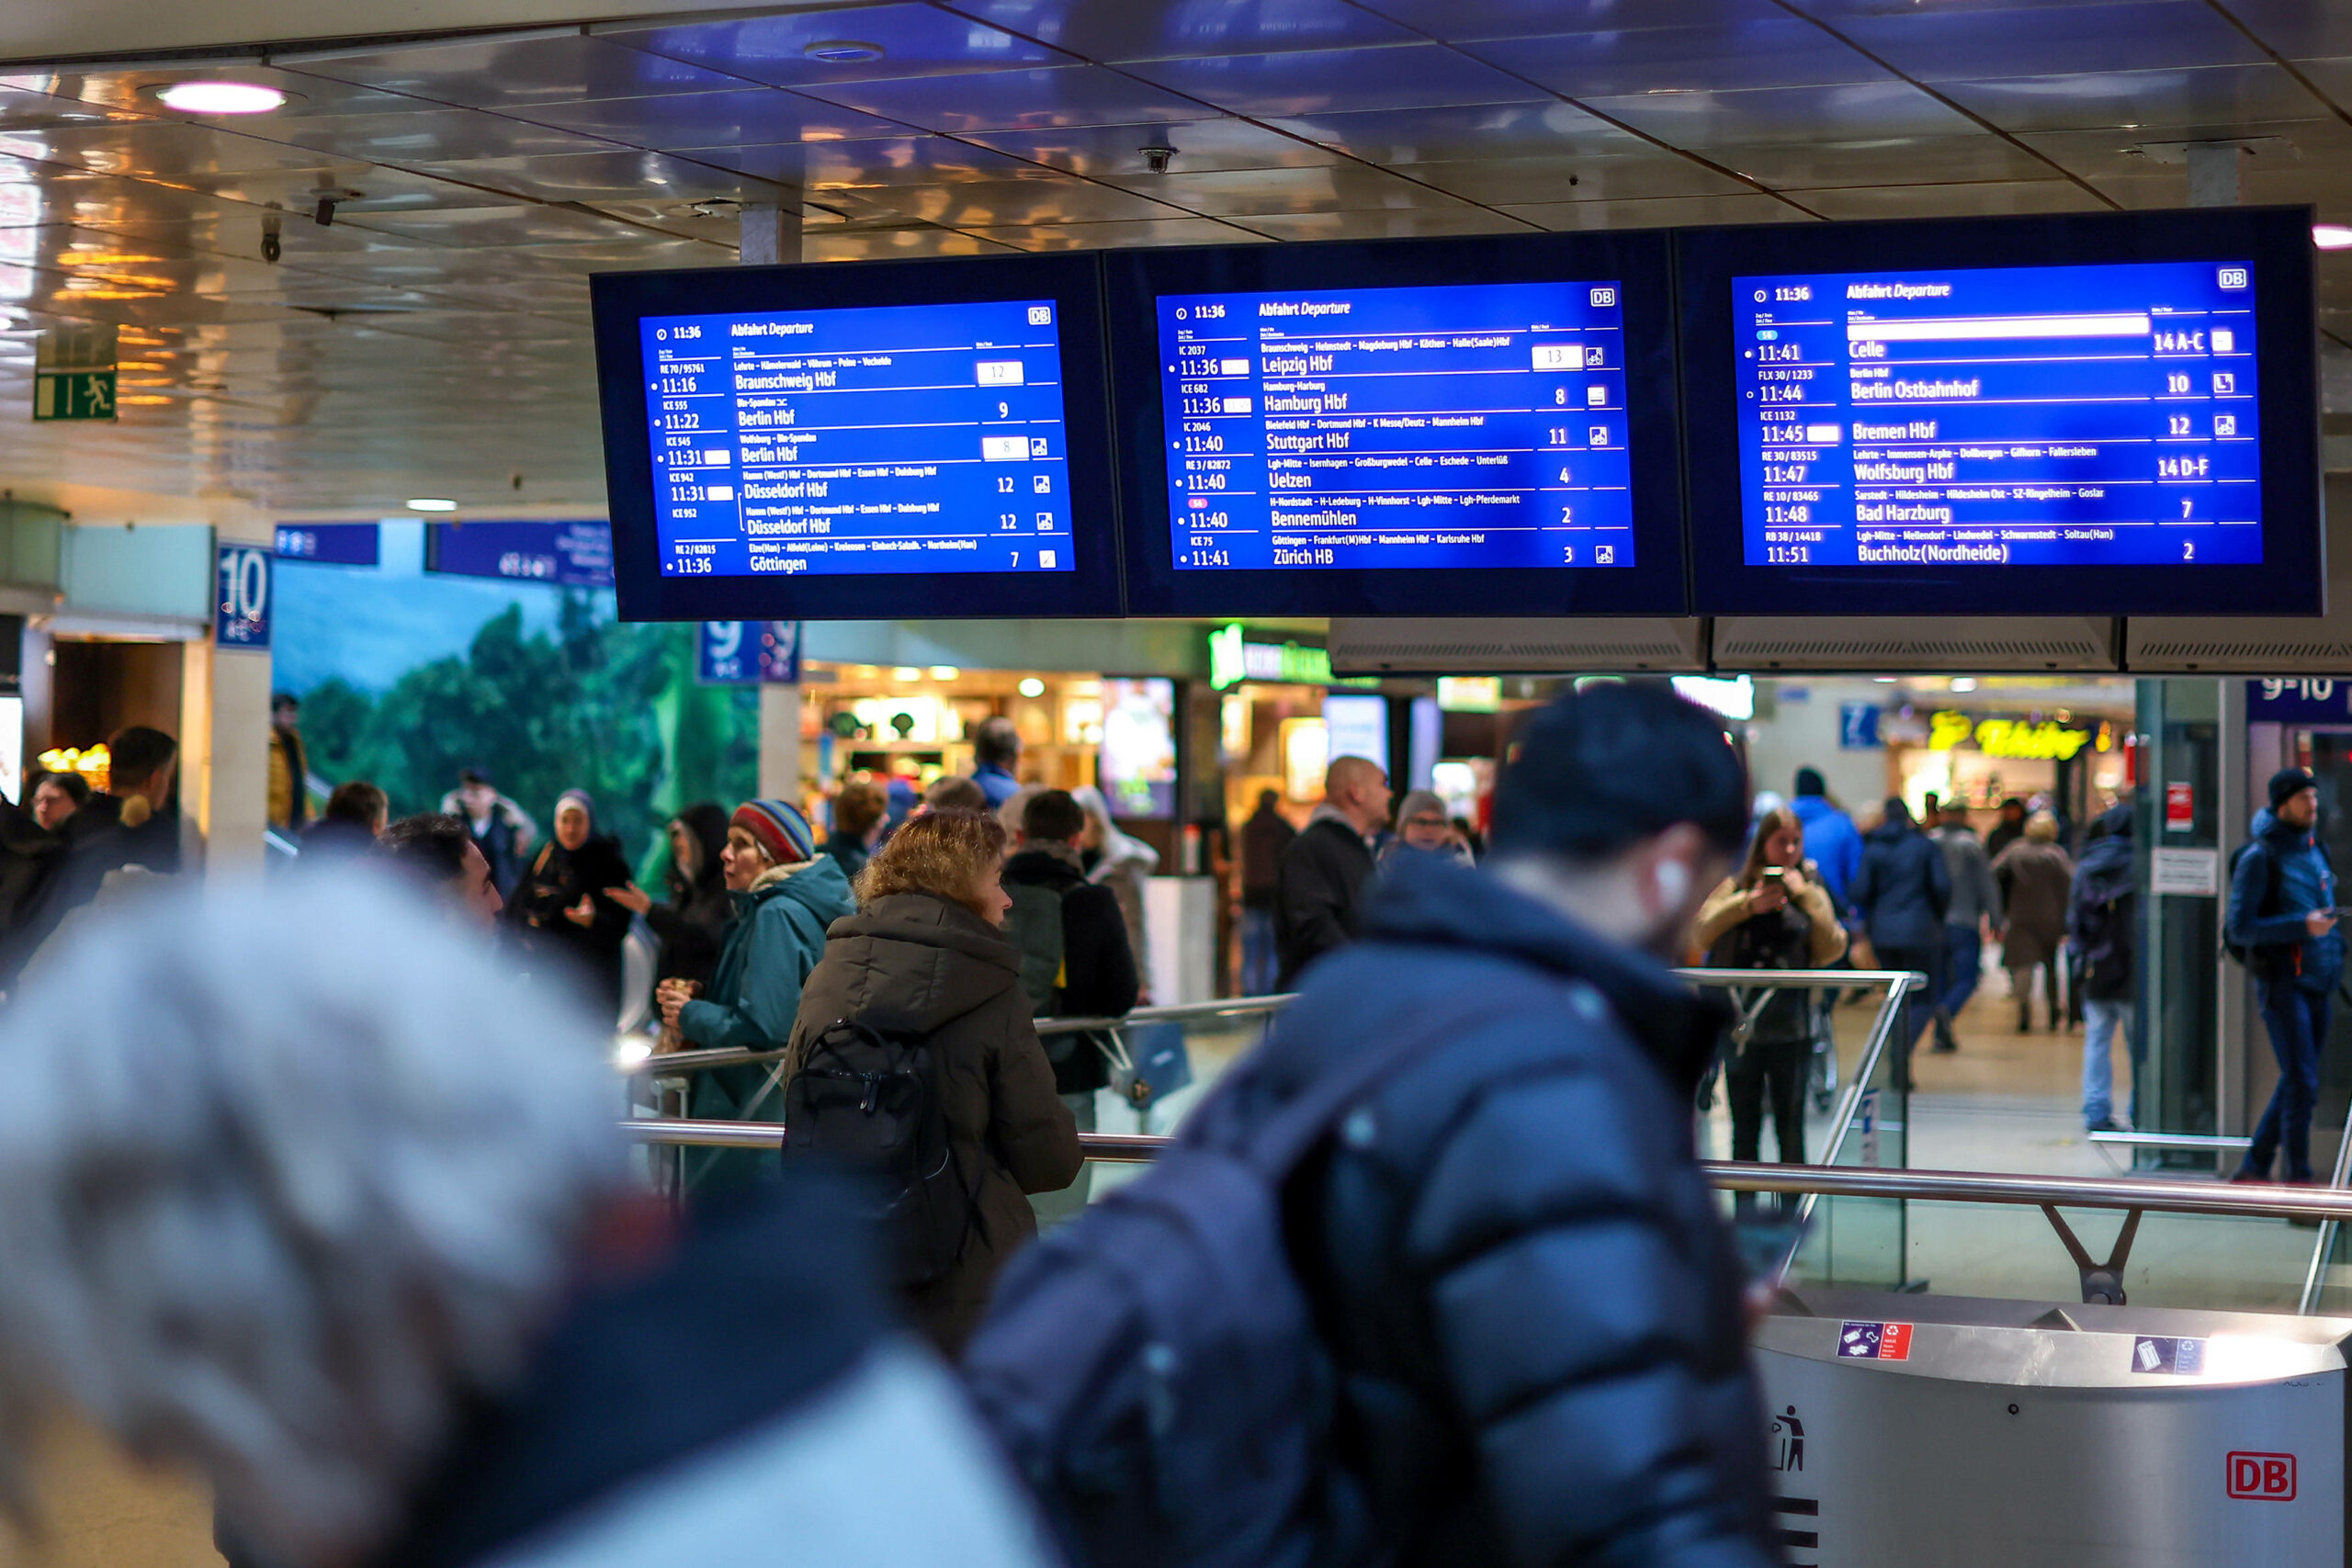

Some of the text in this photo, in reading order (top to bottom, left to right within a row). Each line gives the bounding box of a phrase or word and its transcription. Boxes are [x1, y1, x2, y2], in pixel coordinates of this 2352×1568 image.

[2222, 271, 2245, 287] DB
[1592, 290, 1612, 305] DB
[1775, 287, 1810, 301] 11:36
[1847, 284, 1951, 300] Abfahrt Departure
[1030, 309, 1049, 322] DB
[1195, 305, 1226, 318] 11:36
[1259, 302, 1351, 318] Abfahrt Departure
[673, 325, 701, 339] 11:36
[731, 322, 813, 337] Abfahrt Departure
[1762, 331, 1774, 340] S6
[1179, 345, 1205, 355] IC 2037
[1261, 339, 1445, 354] Braunschweig Helmstedt Magdeburg Hbf Köthen
[1849, 341, 1884, 358] Celle
[2154, 333, 2204, 352] 14 A-C
[1548, 349, 1562, 363] 13
[1758, 344, 1800, 361] 11:41
[660, 365, 669, 374] RE
[991, 366, 1004, 378] 12
[1182, 359, 1218, 376] 11:36
[1262, 355, 1333, 376] Leipzig Hbf
[1873, 367, 1889, 378] Hbf
[735, 371, 836, 390] Braunschweig Hbf
[1758, 371, 1773, 380] FLX
[662, 377, 696, 393] 11:16
[1182, 384, 1208, 393] ICE 682
[1850, 379, 1979, 400] Berlin Ostbahnhof
[2168, 375, 2189, 393] 10
[1555, 389, 1566, 404] 8
[1760, 385, 1803, 401] 11:44
[663, 400, 688, 411] ICE 555
[999, 402, 1008, 418] 9
[1183, 397, 1220, 413] 11:36
[1264, 393, 1348, 413] Hamburg Hbf
[665, 413, 699, 429] 11:22
[738, 409, 795, 426] Berlin Hbf
[1265, 416, 1484, 430] Bielefeld Hbf Dortmund Hbf K Mannheim Hbf
[1760, 411, 1795, 421] ICE 1132
[1183, 422, 1211, 432] IC 2046
[1762, 425, 1804, 442] 11:45
[1853, 422, 1936, 440] Bremen Hbf
[2170, 417, 2190, 434] 12
[666, 437, 677, 446] ICE
[1185, 435, 1223, 452] 11:40
[1266, 432, 1350, 453] Stuttgart Hbf
[1549, 428, 1566, 445] 11
[741, 446, 797, 463] Berlin Hbf
[1003, 441, 1011, 452] 8
[1853, 446, 2097, 459] Lehrte Gifhorn Fallersleben
[668, 450, 702, 465] 11:31
[1268, 456, 1509, 470] Lgh-Mitte Isernhagen Großburgwedel Celle Eschede Unterlüß
[1762, 451, 1772, 461] RE
[1185, 460, 1195, 470] RE
[1854, 462, 1954, 483] Wolfsburg Hbf
[2158, 458, 2209, 477] 14 D-F
[669, 473, 680, 482] ICE
[1188, 474, 1226, 490] 11:40
[1269, 472, 1311, 488] Uelzen
[1559, 468, 1569, 483] 4
[1764, 466, 1806, 482] 11:47
[744, 481, 828, 499] Düsseldorf Hbf
[998, 477, 1013, 492] 12
[672, 486, 706, 502] 11:31
[1270, 495, 1520, 507] H-Nordstadt H-Ledeburg H-Vinnhorst Lgh-Mitte Lgh-Pferdemarkt
[1764, 491, 1774, 502] RE
[1855, 488, 2104, 501] Sarstedt Hildesheim Hildesheim Ost Goslar
[673, 509, 684, 518] ICE
[1562, 507, 1571, 523] 2
[1766, 505, 1808, 523] 11:48
[1856, 503, 1951, 524] Bad Harzburg
[2182, 501, 2192, 518] 7
[747, 517, 831, 535] Düsseldorf Hbf
[1001, 513, 1016, 529] 12
[1191, 512, 1227, 528] 11:40
[1272, 510, 1356, 526] Bennemühlen
[1191, 536, 1213, 547] ICE 75
[1272, 534, 1485, 547] Göttingen Mannheim Hbf Karlsruhe Hbf
[1766, 532, 1777, 541] RB
[1857, 529, 2113, 543] Lgh-Mitte Mellendorf Lindwedel Schwarmstedt Soltau(Han)
[1193, 550, 1229, 566] 11:41
[1273, 548, 1333, 564] Zürich HB
[1564, 547, 1573, 563] 3
[1768, 547, 1808, 563] 11:51
[1858, 544, 2008, 564] Buchholz(Nordheide)
[2184, 543, 2193, 559] 2
[678, 558, 712, 573] 11:36
[750, 556, 807, 574] Göttingen
[1011, 552, 1019, 568] 7
[220, 550, 266, 615] 10
[707, 621, 742, 659] 9
[2262, 679, 2334, 701] 9-10
[2232, 1456, 2291, 1496] DB
